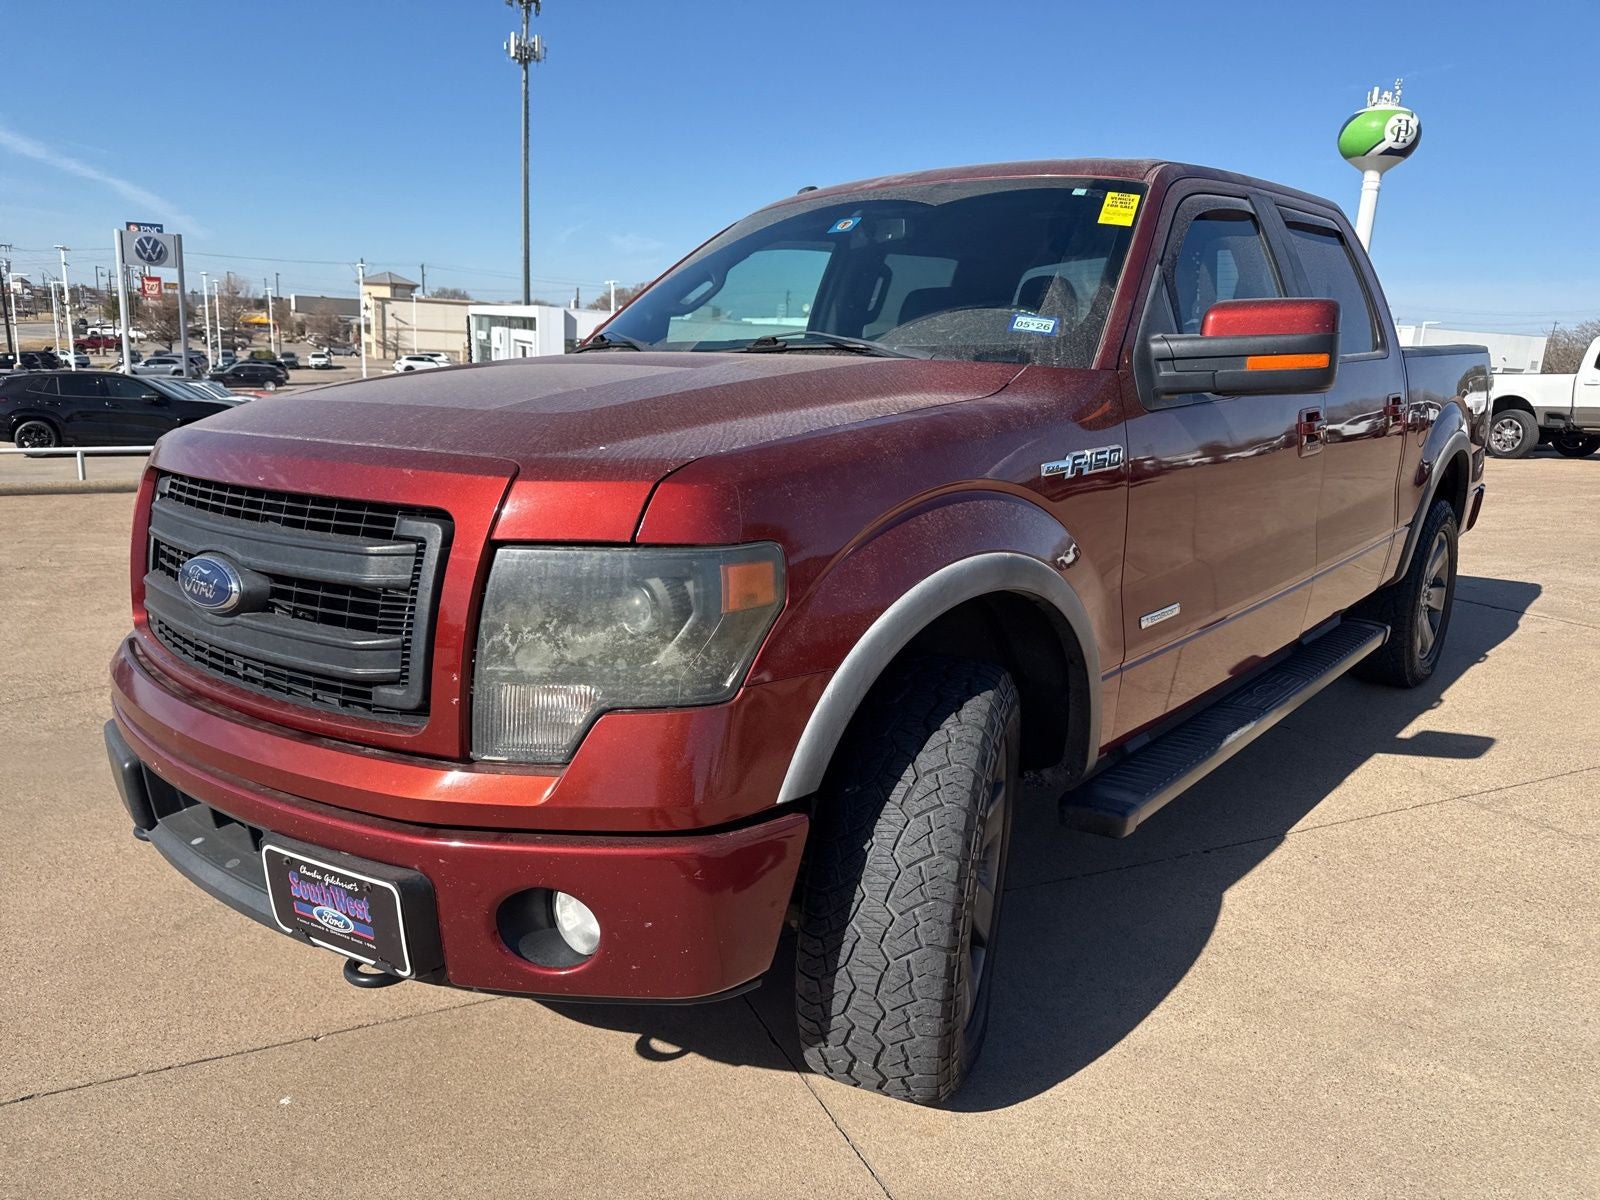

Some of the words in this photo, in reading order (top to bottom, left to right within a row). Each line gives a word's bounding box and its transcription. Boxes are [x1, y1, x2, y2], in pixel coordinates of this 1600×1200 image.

[140, 225, 161, 233] PNC
[184, 565, 218, 599] Ford
[322, 910, 346, 929] Ford
